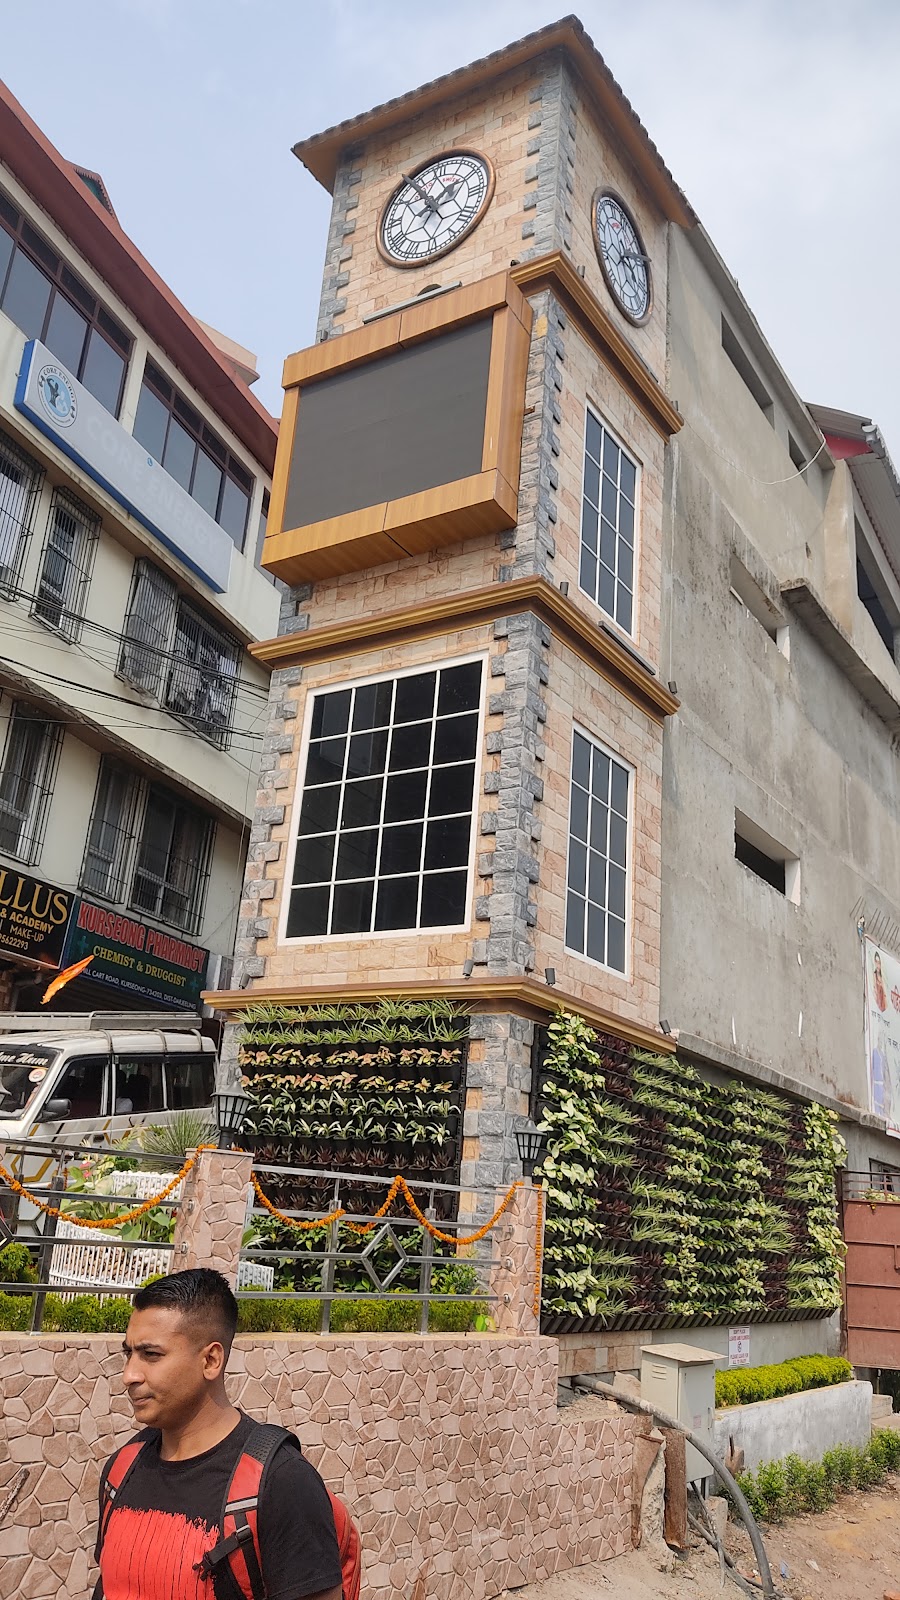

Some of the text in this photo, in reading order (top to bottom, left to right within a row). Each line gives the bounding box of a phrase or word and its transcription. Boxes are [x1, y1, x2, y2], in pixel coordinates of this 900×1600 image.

[9, 911, 54, 934] ACADEMY
[9, 924, 45, 943] MAKE-UP
[77, 900, 206, 974] KURSEONG PHARMACY
[92, 970, 105, 980] CART
[93, 945, 187, 987] CHEMIST & DRUGGIST
